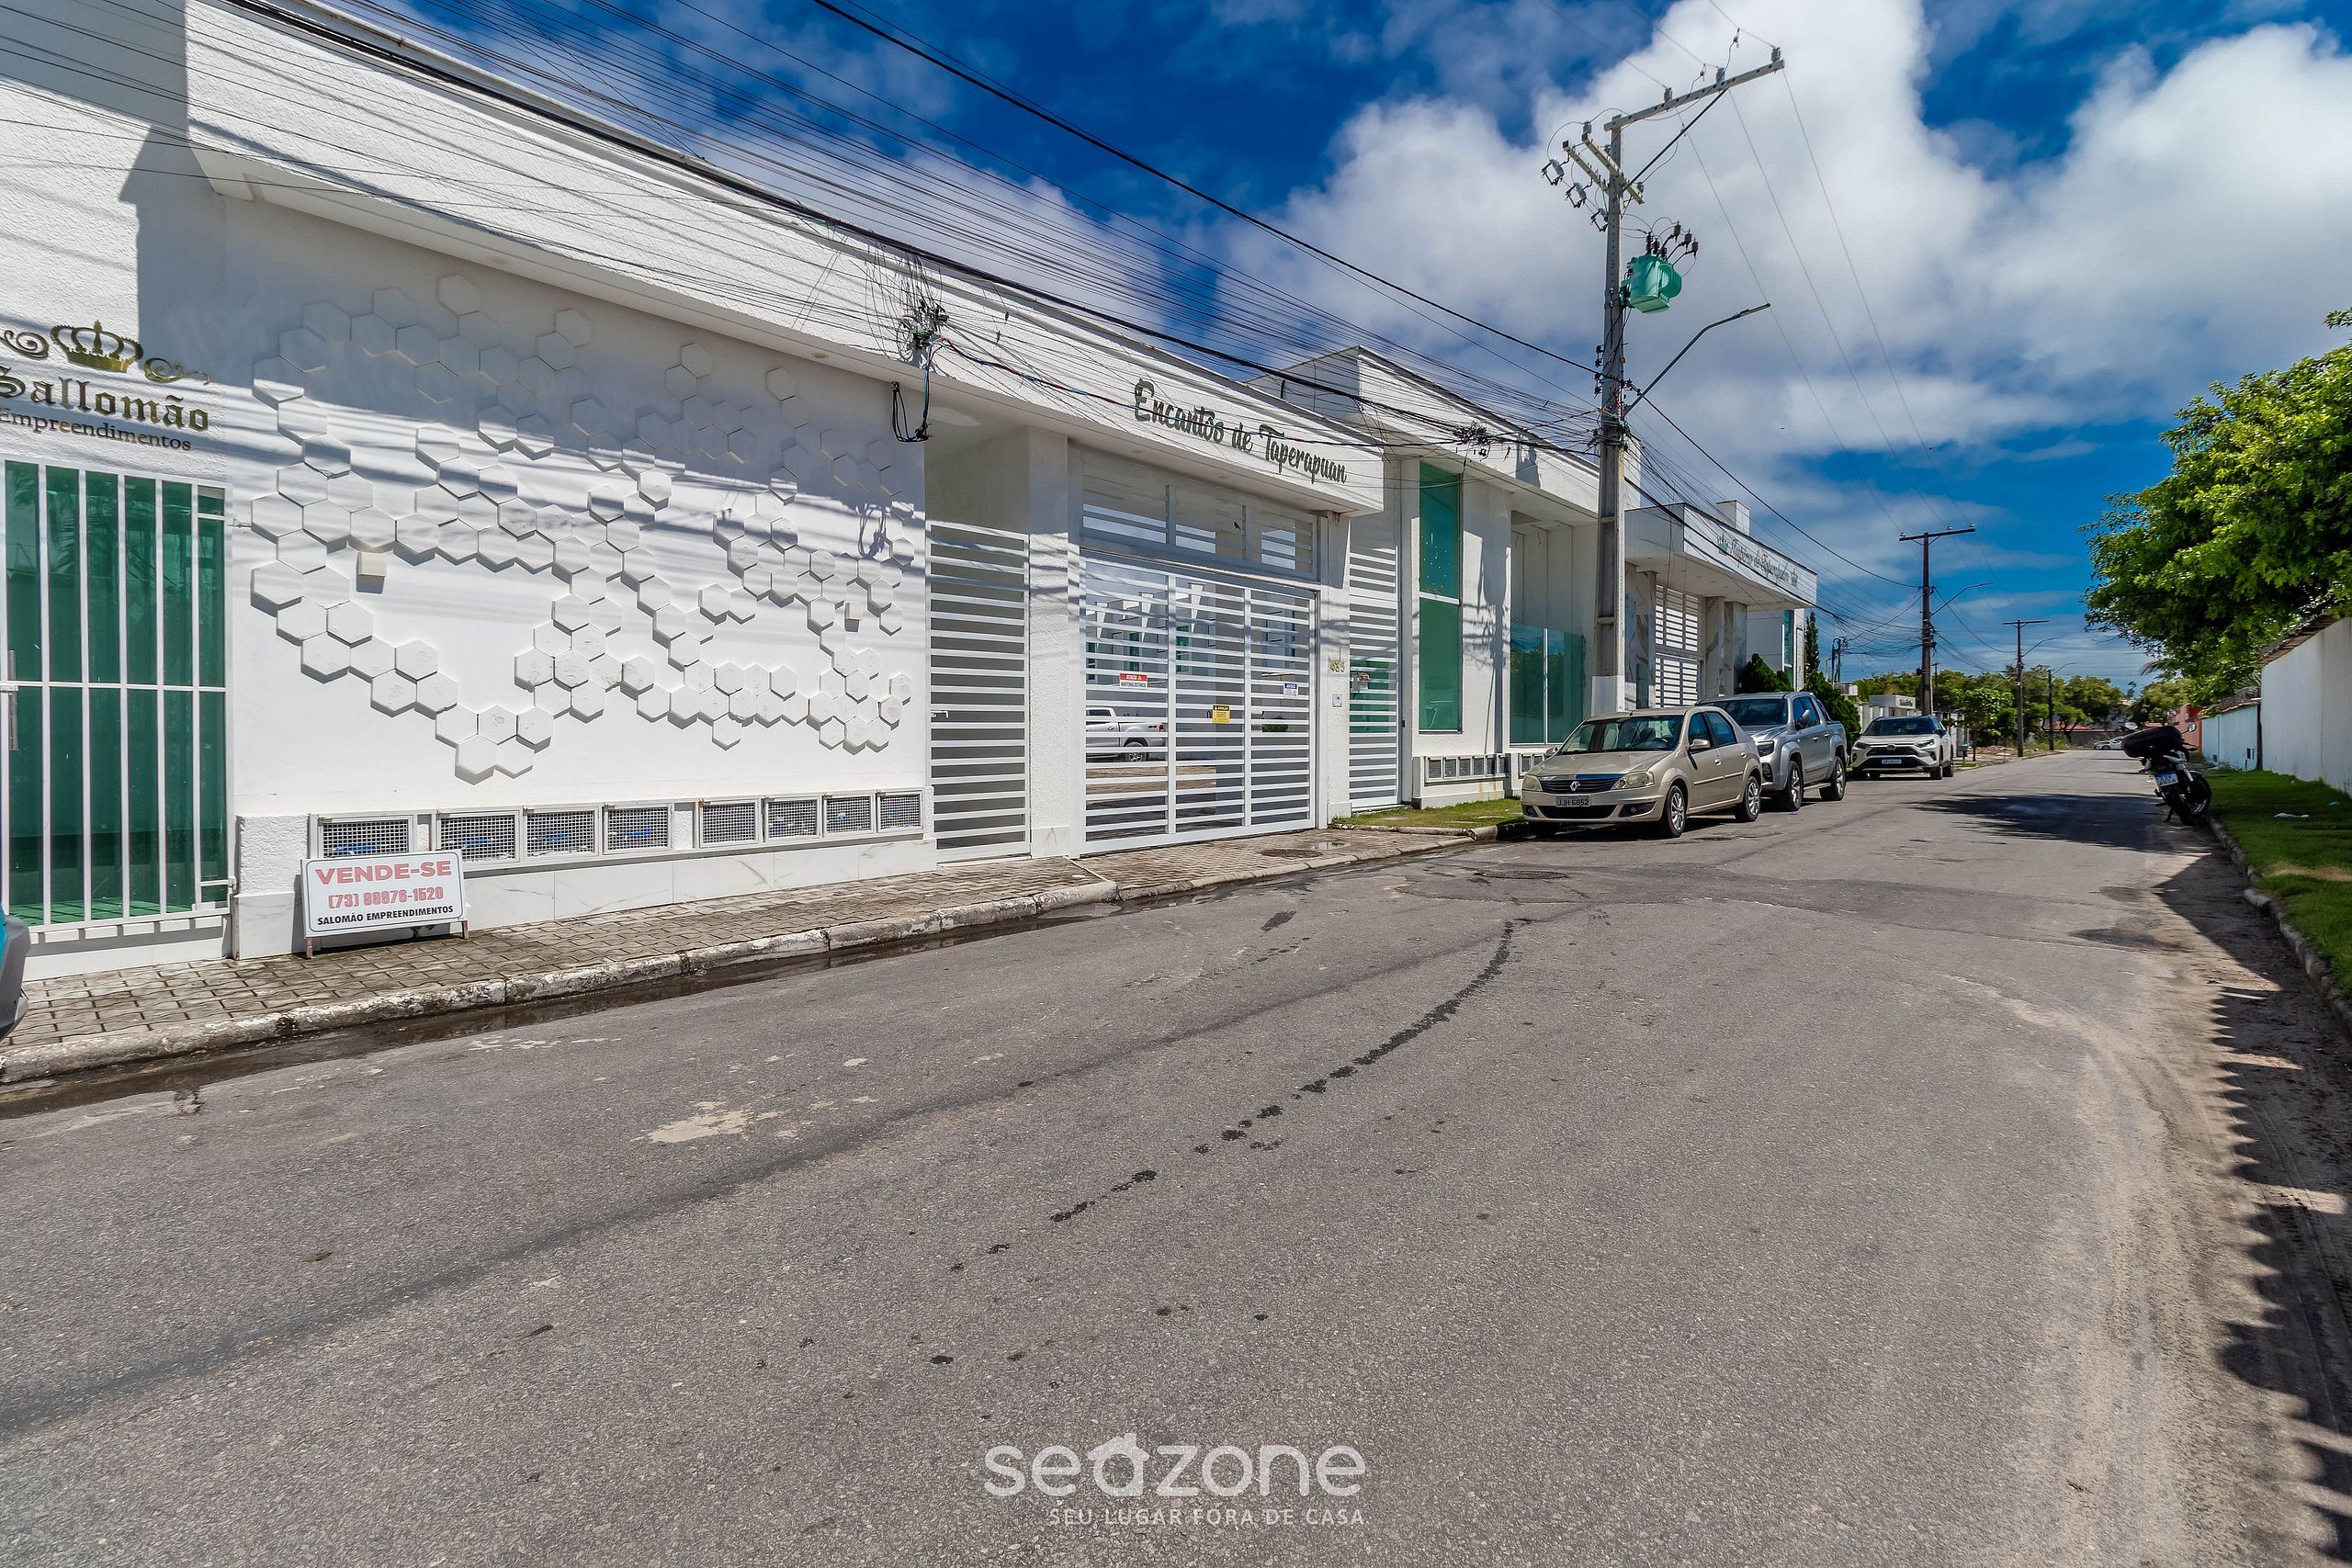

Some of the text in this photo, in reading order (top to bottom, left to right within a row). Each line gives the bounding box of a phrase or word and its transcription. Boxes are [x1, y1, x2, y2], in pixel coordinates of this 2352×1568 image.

[0, 407, 192, 451] Empreendimentos
[1231, 422, 1253, 454] de
[315, 861, 452, 885] VENDE-SE
[328, 893, 359, 908] (73)
[317, 905, 454, 925] SALOMÃO EMPREENDIMENTOS
